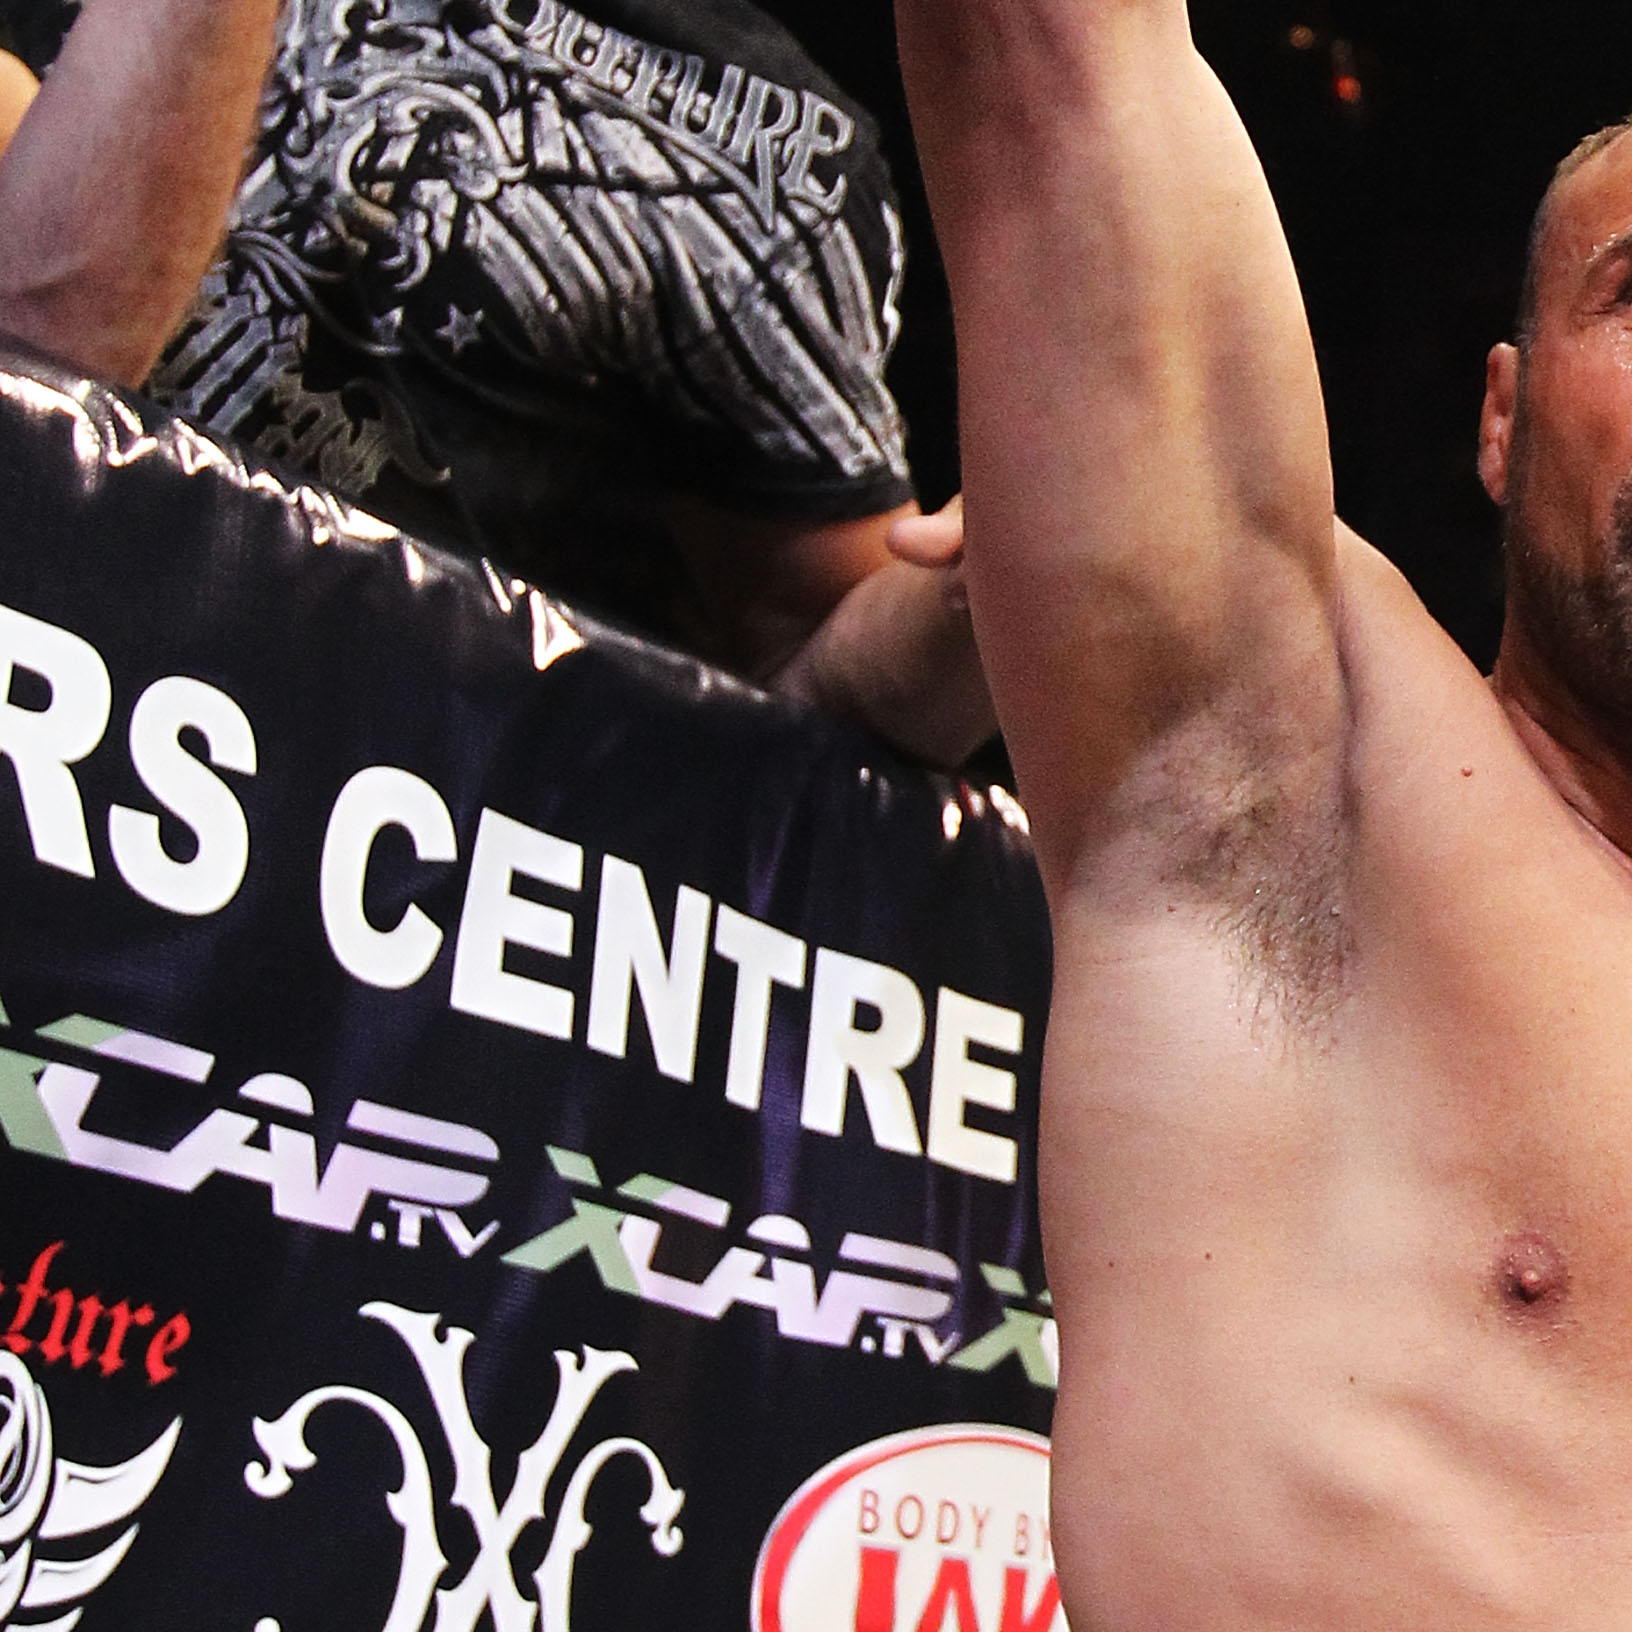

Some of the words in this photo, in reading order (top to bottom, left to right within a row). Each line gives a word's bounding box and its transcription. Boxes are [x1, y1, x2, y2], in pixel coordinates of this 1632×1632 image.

[319, 765, 1024, 1184] CENTRE
[1, 1239, 191, 1386] ture
[857, 1489, 995, 1550] BODY
